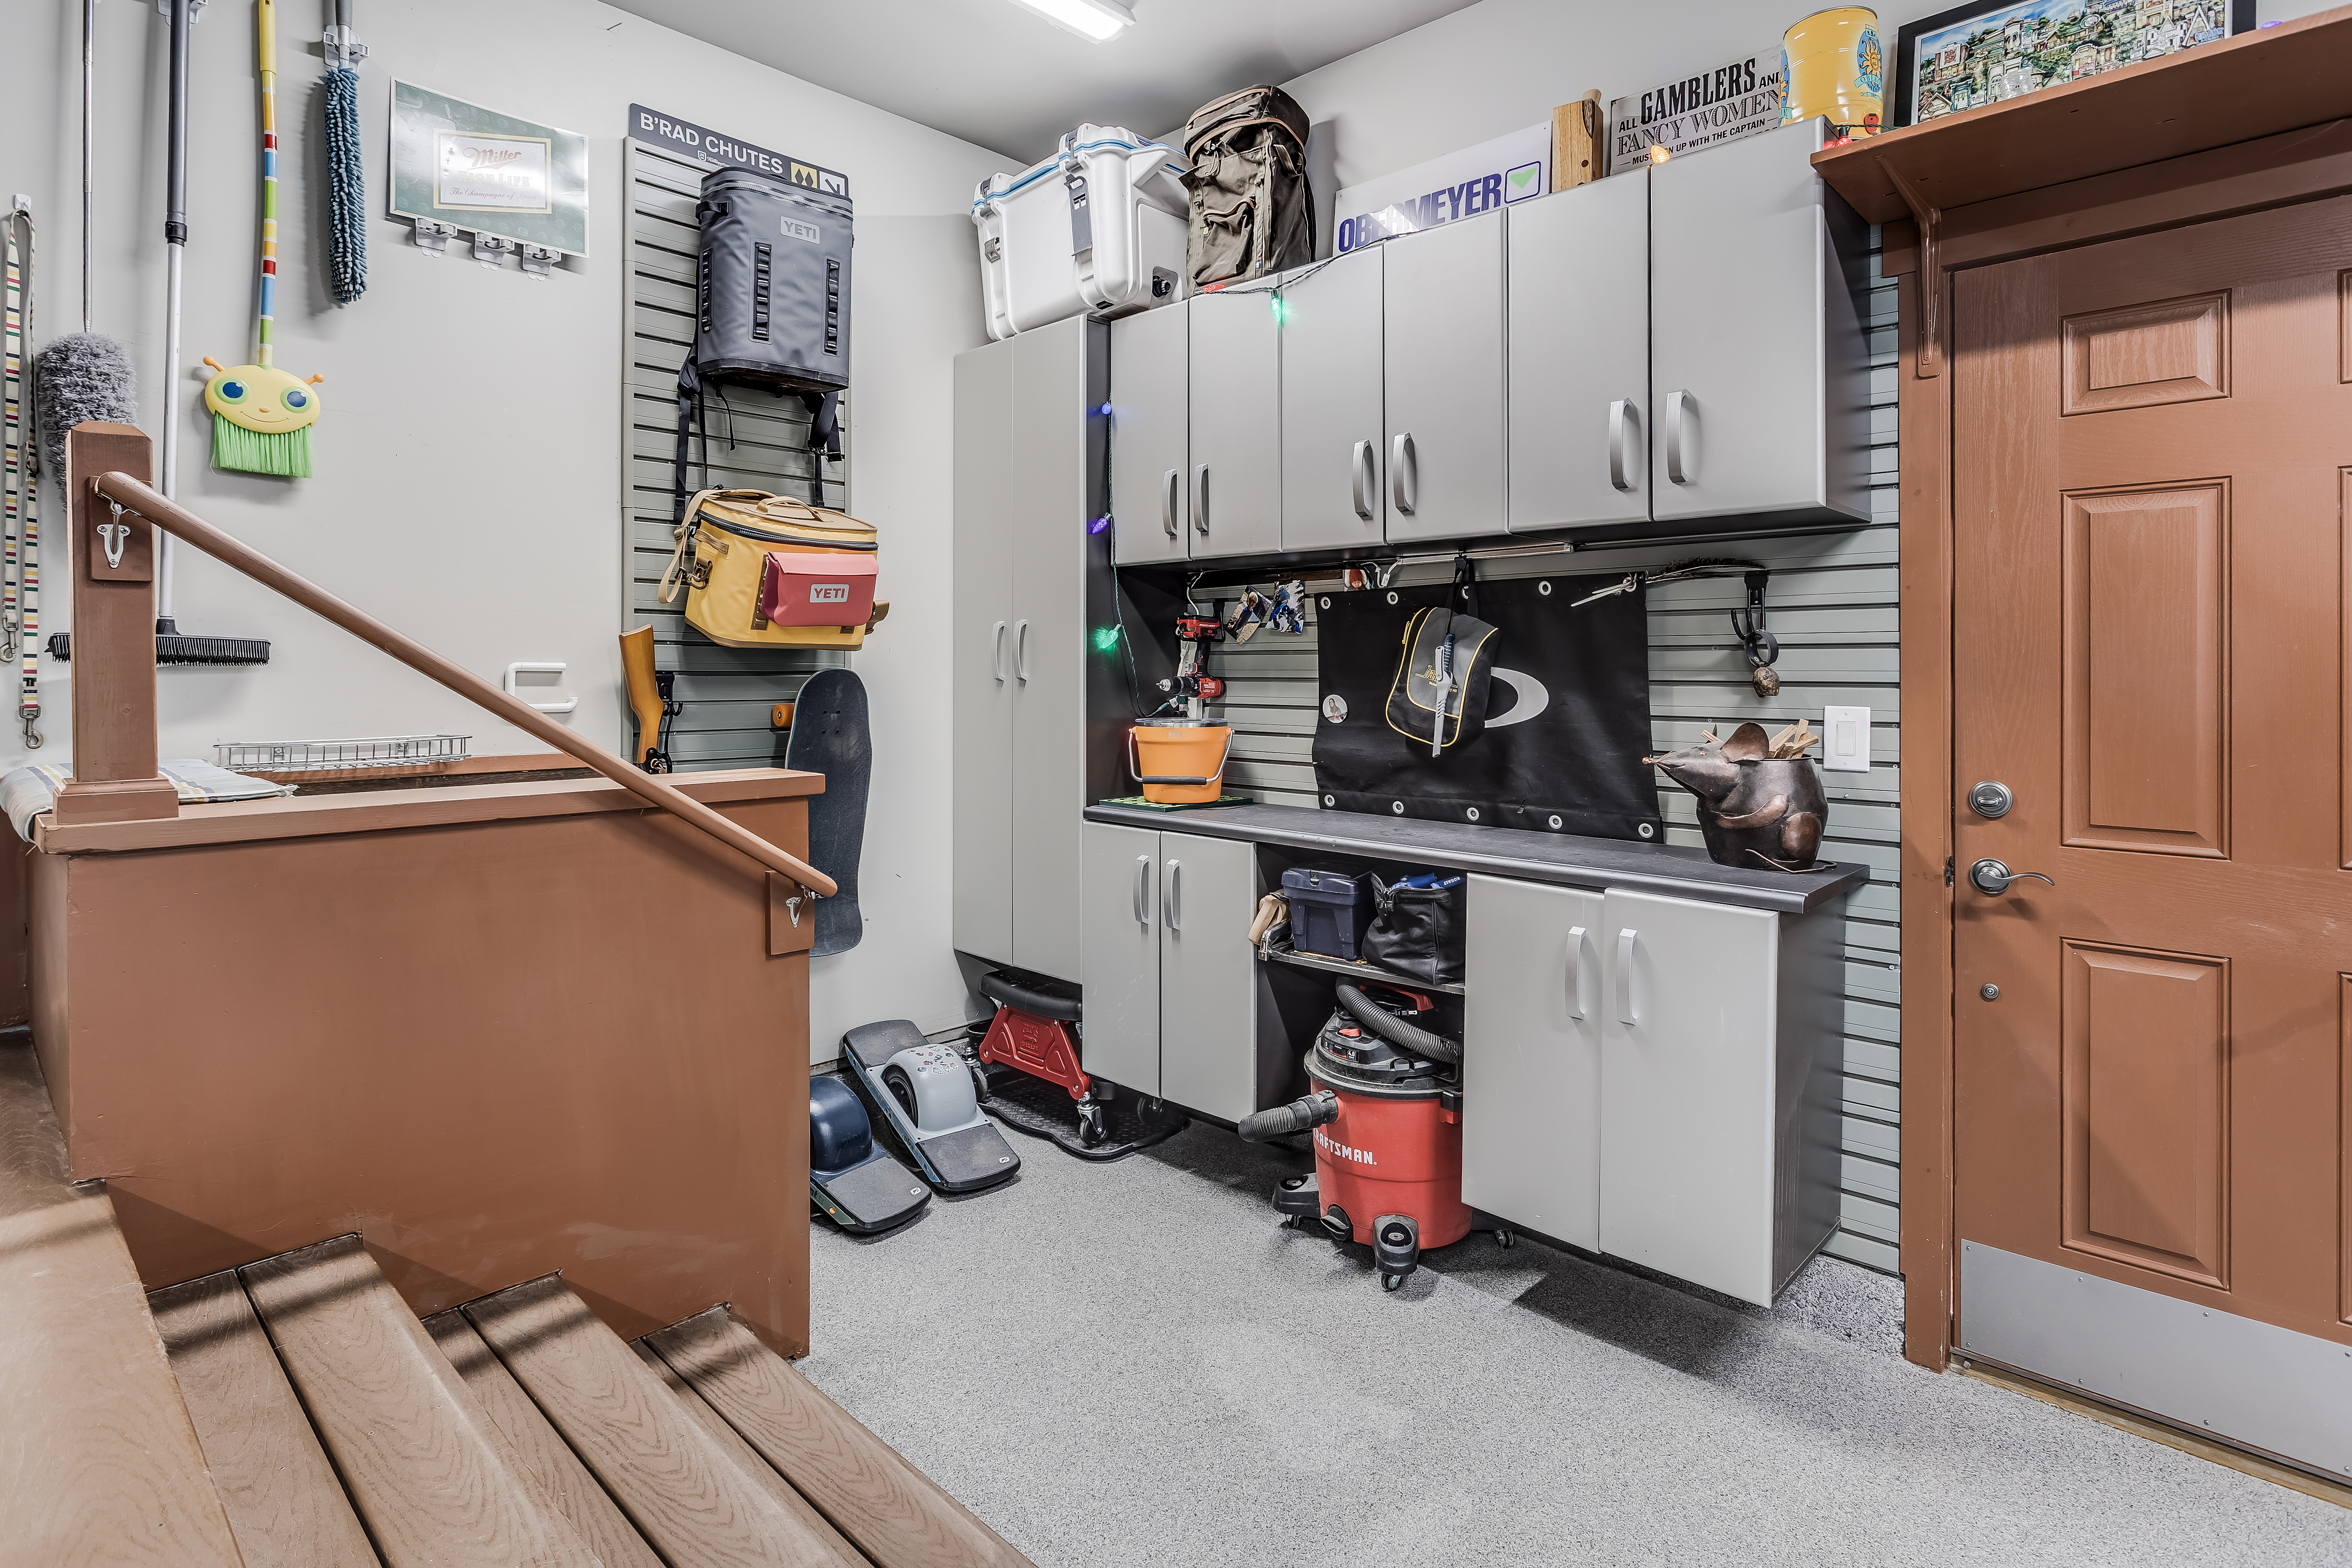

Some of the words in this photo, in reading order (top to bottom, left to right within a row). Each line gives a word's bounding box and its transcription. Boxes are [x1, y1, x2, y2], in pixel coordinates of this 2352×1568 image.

[1618, 117, 1638, 133] ALL
[1640, 57, 1756, 126] GAMBLERS
[1616, 116, 1686, 157] FANCY
[1689, 89, 1779, 134] WOMEN
[640, 111, 700, 146] B'RAD
[705, 135, 784, 175] CHUTES
[1676, 142, 1687, 152] UP
[1689, 135, 1710, 149] WITH
[1712, 129, 1728, 142] THE
[1729, 117, 1766, 136] CAPTAIN
[462, 147, 523, 168] Miller
[457, 170, 495, 185] HIGH
[498, 173, 530, 187] LIFE
[449, 187, 463, 196] The
[463, 188, 505, 200] Champagne
[507, 191, 516, 200] of
[516, 192, 537, 200] Beers
[1338, 173, 1502, 253] OBERMEYER
[783, 220, 817, 240] YETI
[813, 588, 845, 600] YETI
[1443, 876, 1461, 885] KOBALT
